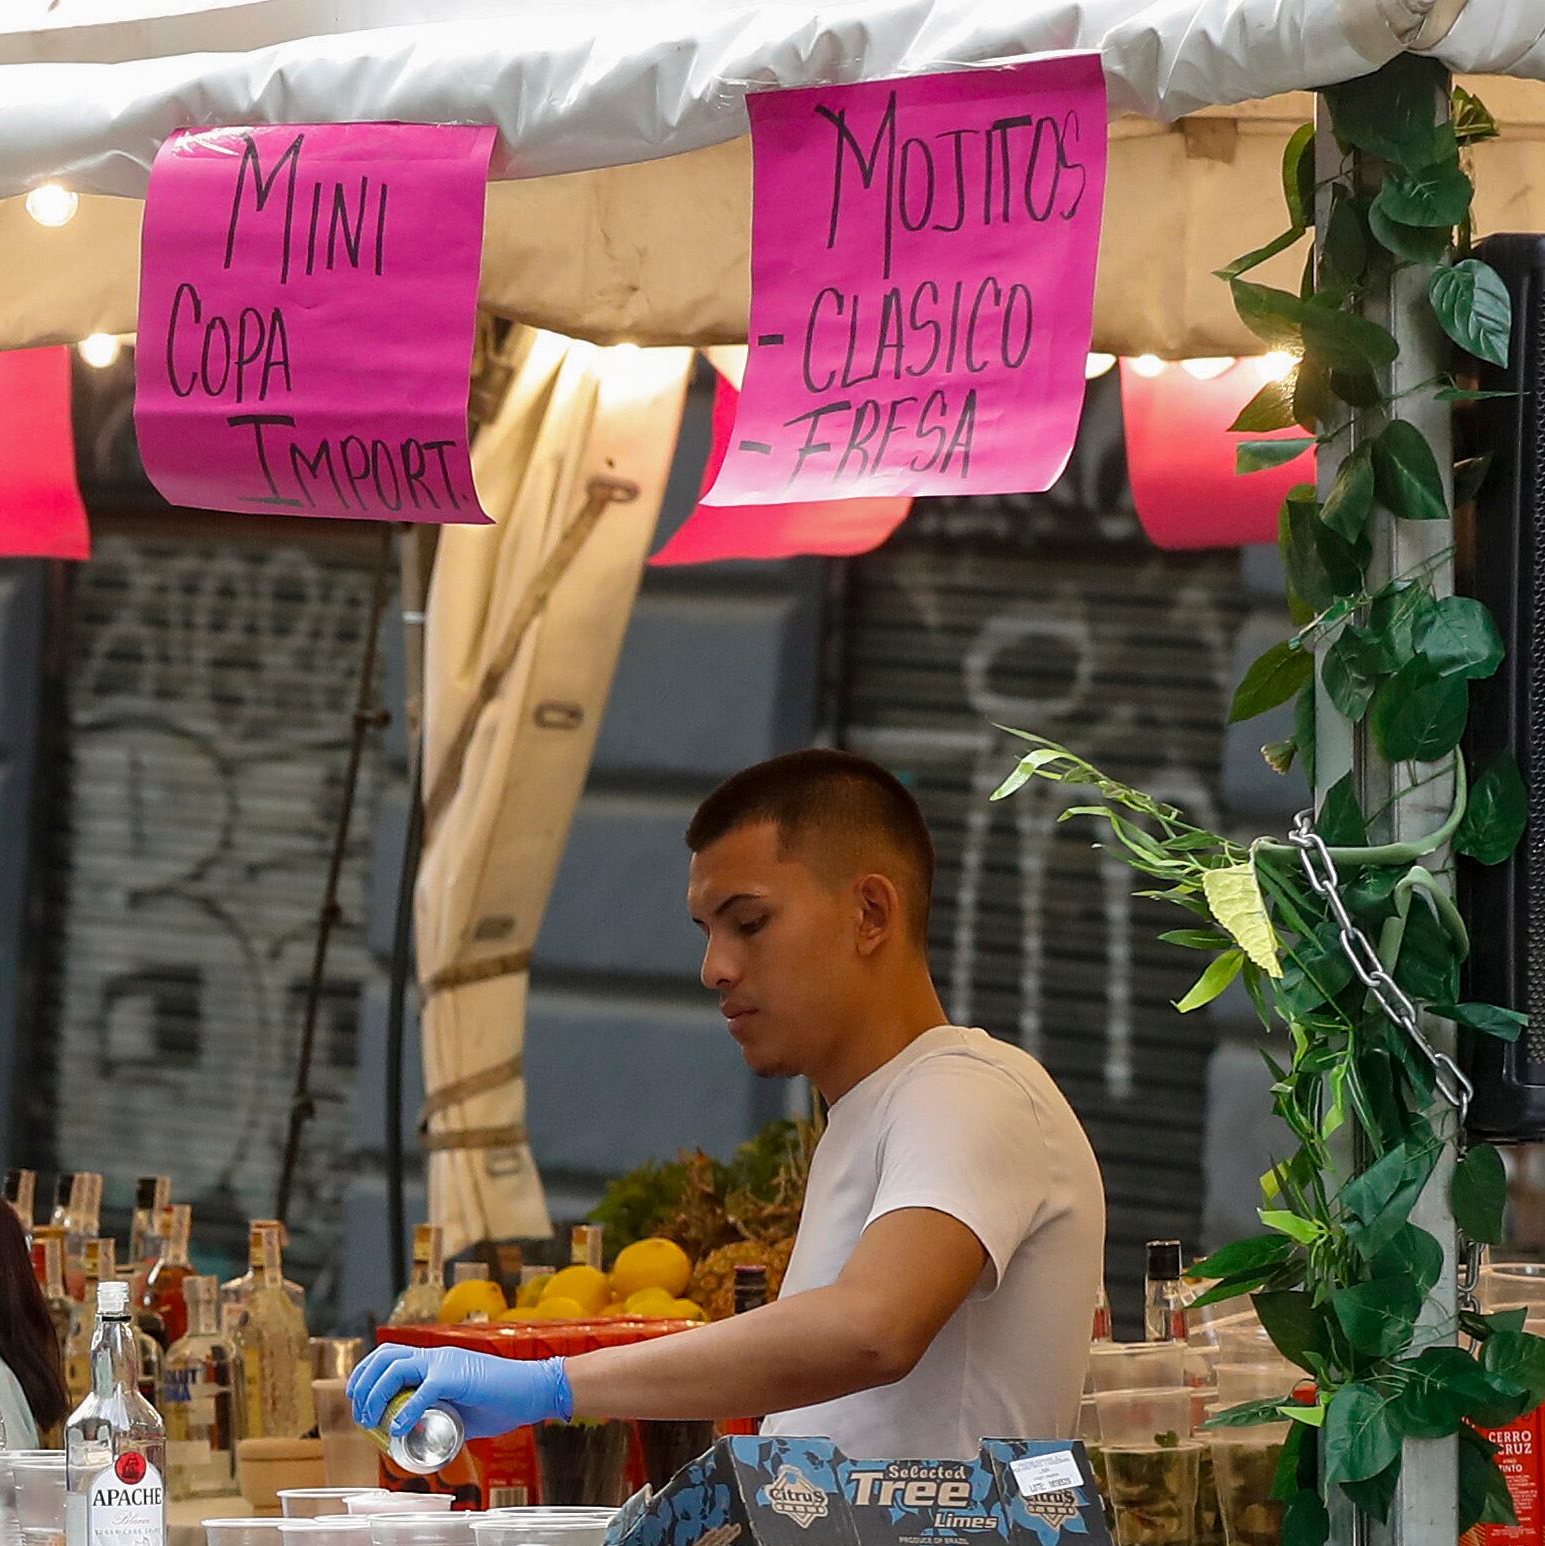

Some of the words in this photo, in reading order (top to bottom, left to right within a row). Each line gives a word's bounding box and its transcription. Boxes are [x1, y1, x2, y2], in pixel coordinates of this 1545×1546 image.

[816, 91, 1086, 278] MOJITOS
[223, 131, 387, 285] MINI
[166, 282, 292, 403] COPA
[1489, 1430, 1532, 1444] CERRO
[888, 1464, 967, 1481] Selected
[93, 1487, 162, 1507] APACHE
[849, 1471, 972, 1508] Tree
[934, 1513, 997, 1530] Limes
